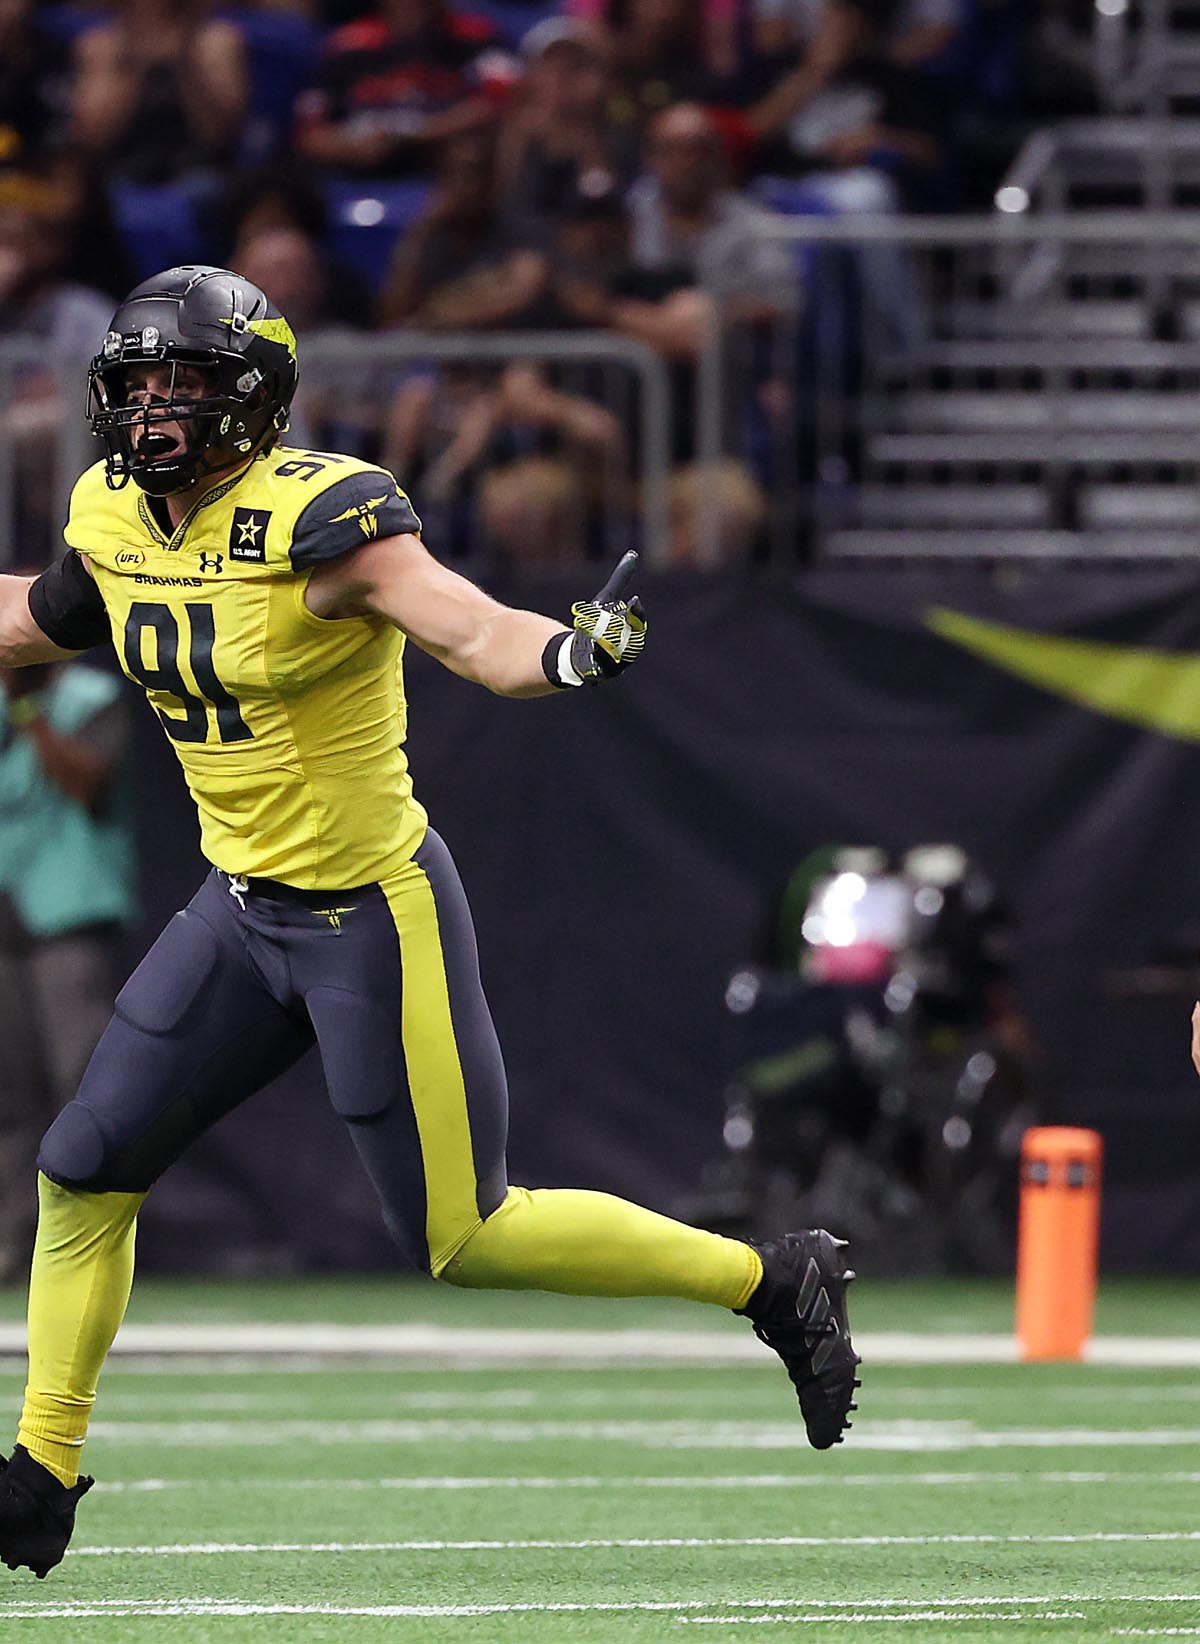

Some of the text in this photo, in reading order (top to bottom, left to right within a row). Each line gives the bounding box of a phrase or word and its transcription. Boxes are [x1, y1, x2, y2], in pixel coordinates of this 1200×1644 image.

[274, 452, 345, 482] 91
[120, 553, 140, 564] UFL
[244, 549, 261, 558] ARMY
[134, 573, 203, 587] BRAHMAS
[124, 601, 255, 744] 91
